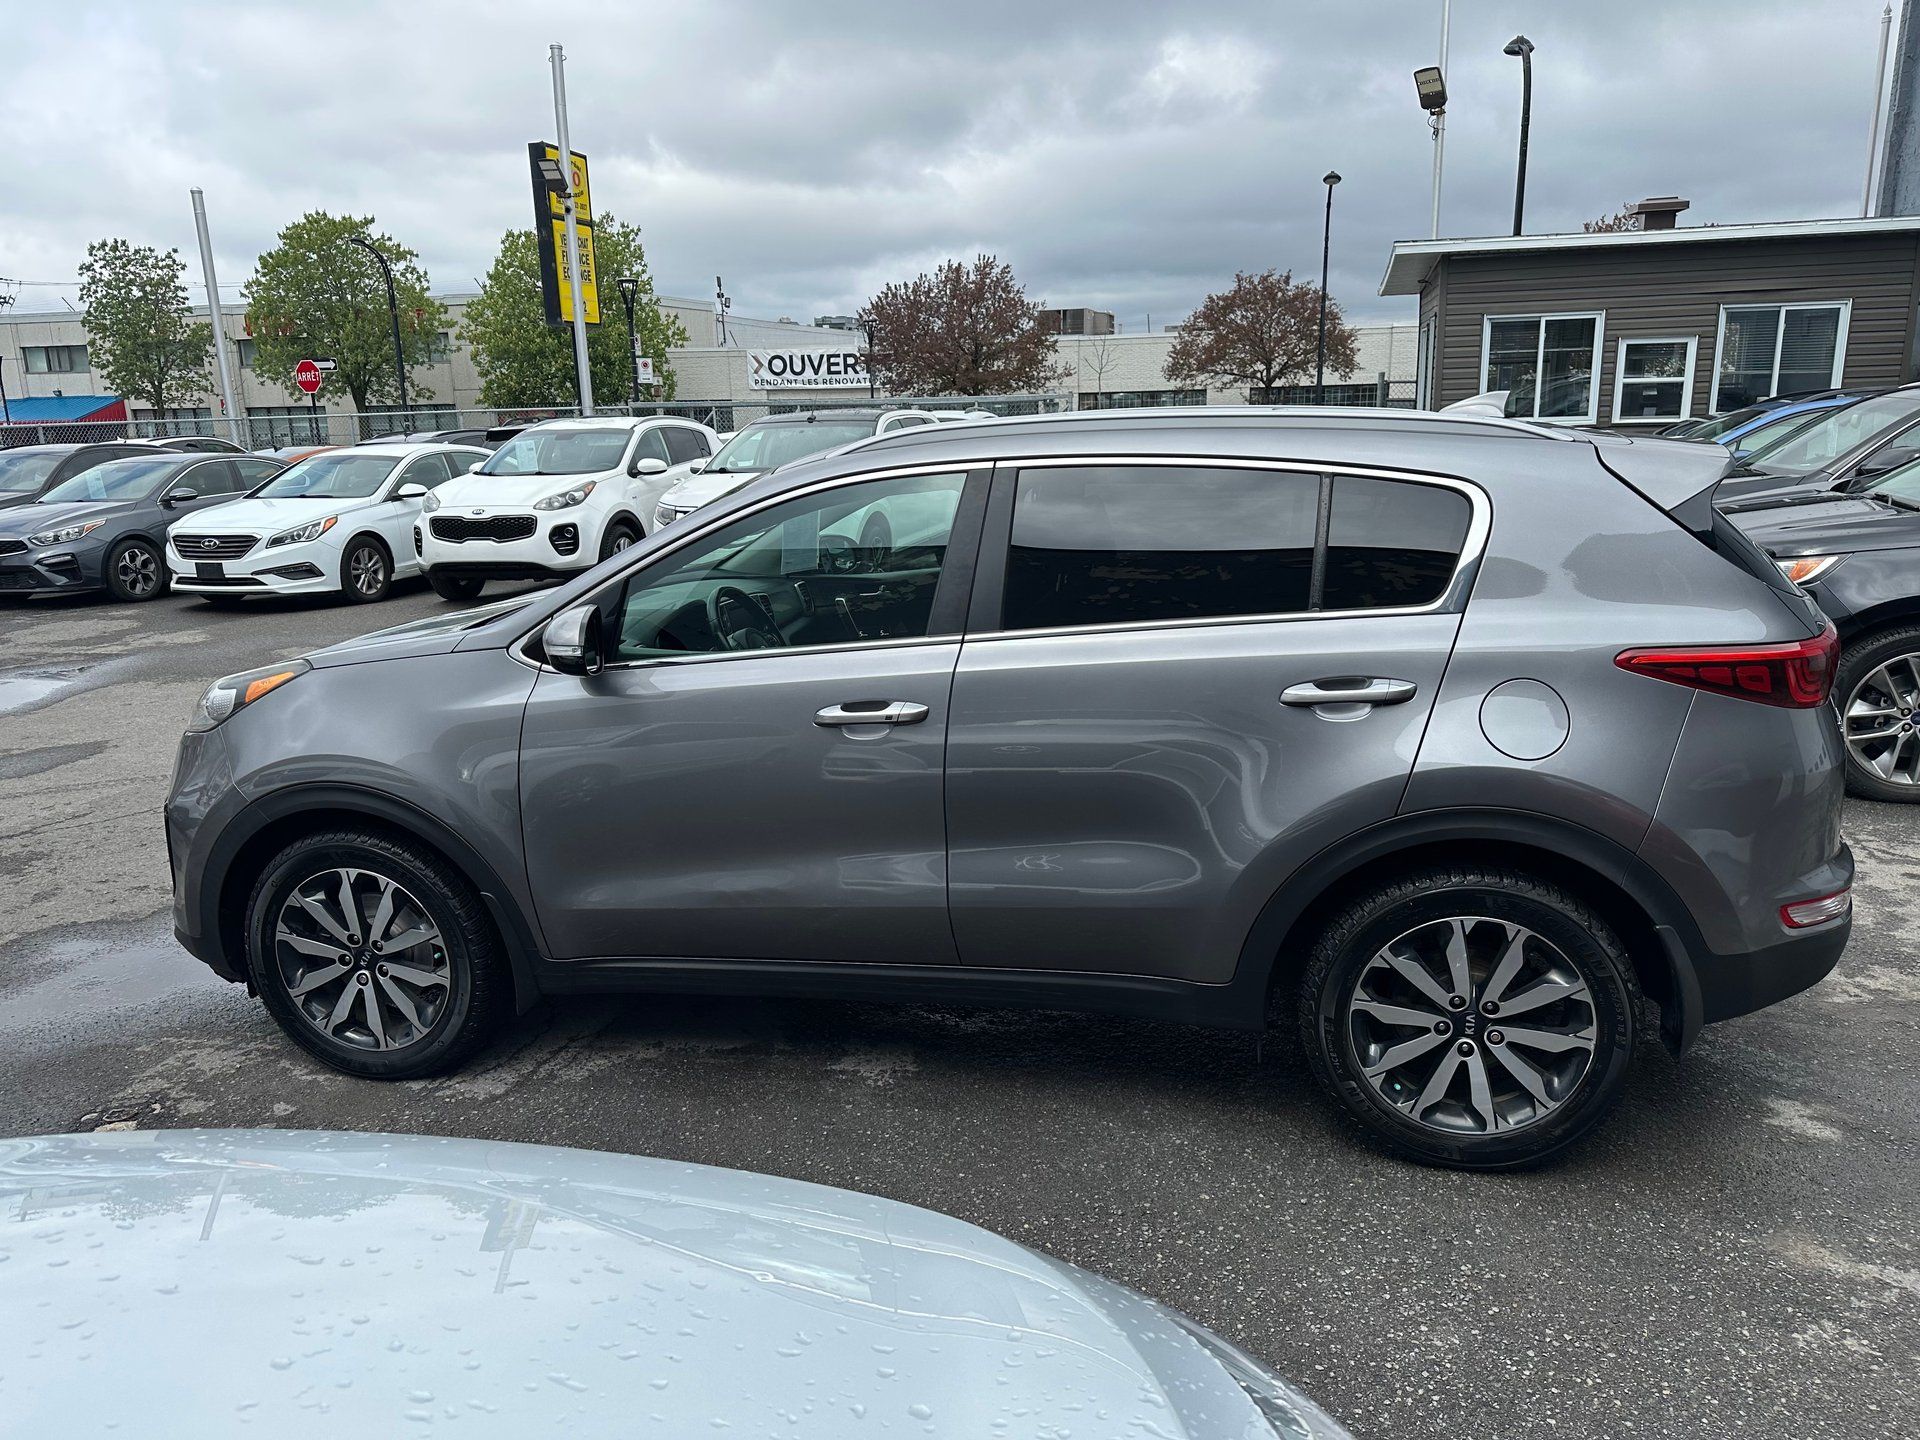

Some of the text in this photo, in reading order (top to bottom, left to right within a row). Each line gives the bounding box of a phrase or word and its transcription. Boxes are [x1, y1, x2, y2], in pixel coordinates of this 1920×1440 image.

[561, 250, 590, 266] FICE
[563, 267, 592, 282] ECNGE
[298, 370, 319, 382] ARRÊT
[755, 378, 798, 386] PENDANT
[802, 378, 819, 386] LES
[360, 951, 372, 967] KIA
[1465, 1014, 1475, 1035] KIA
